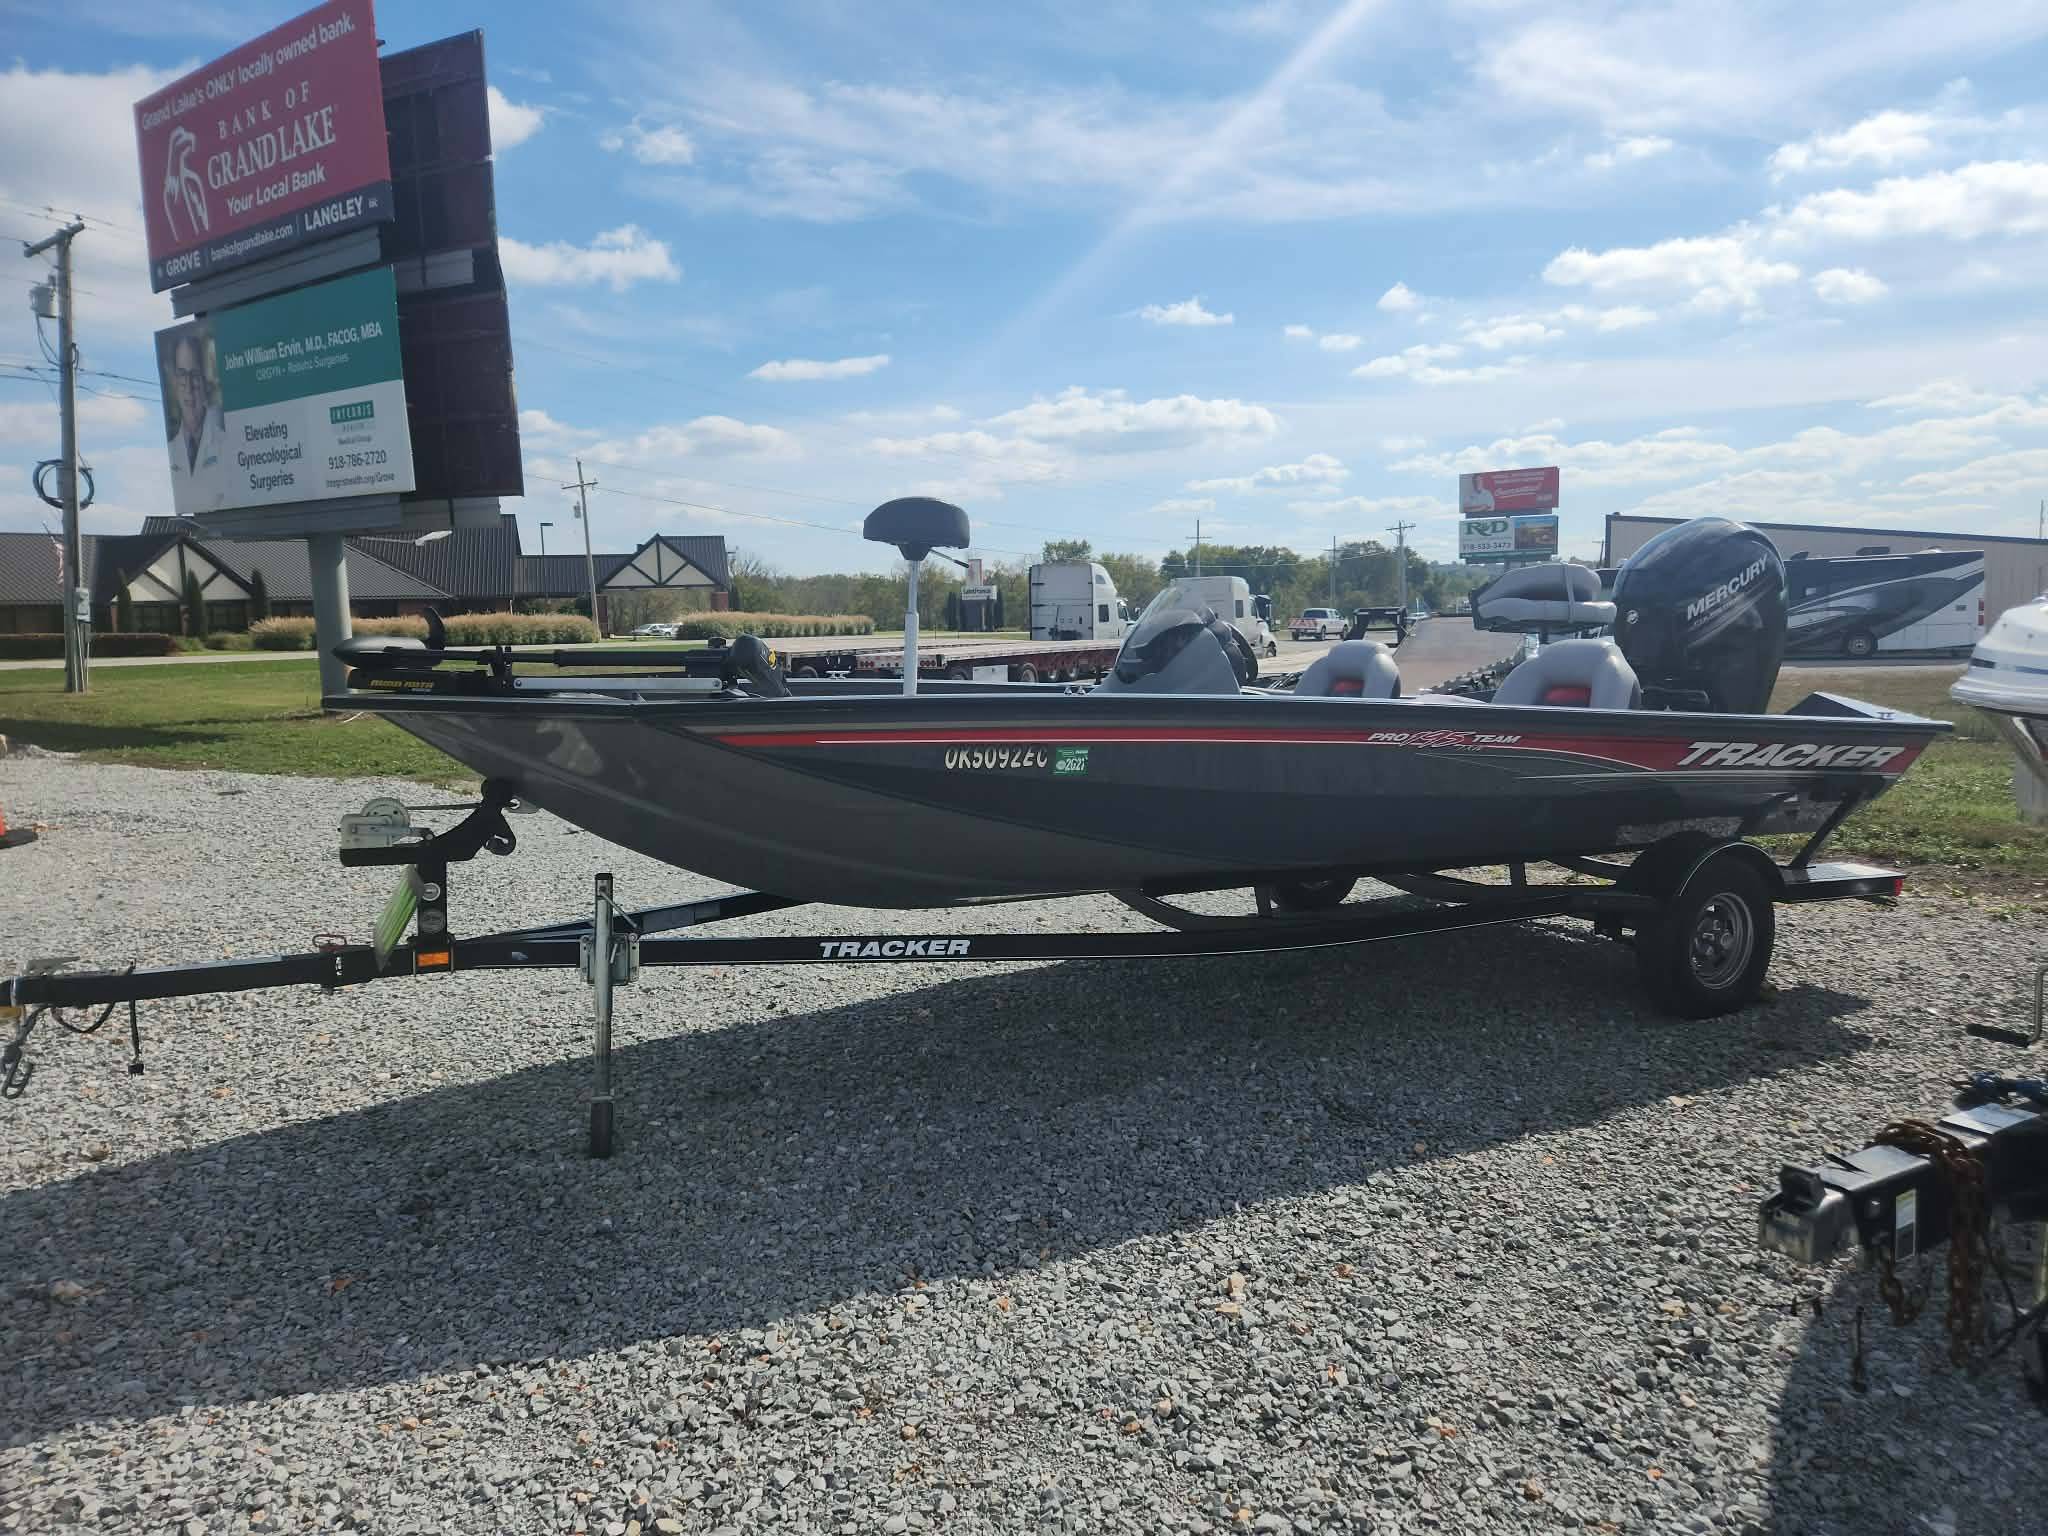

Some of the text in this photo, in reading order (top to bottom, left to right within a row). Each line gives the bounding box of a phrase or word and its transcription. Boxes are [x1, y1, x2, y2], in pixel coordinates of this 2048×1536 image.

[142, 12, 356, 130] Grand Lake's ONLY locally owned bank.
[217, 80, 311, 139] BANK OF
[226, 162, 327, 217] Your Local Bank
[166, 250, 201, 277] GROVE
[304, 196, 364, 232] LANGLEY
[224, 353, 245, 371] John
[246, 344, 278, 366] William
[278, 338, 305, 358] Ervin,
[327, 327, 361, 347] FACOG,
[361, 321, 383, 339] MBA
[244, 421, 289, 442] Elevating
[237, 443, 304, 471] Gynecological
[328, 449, 387, 470] 918-786-2720
[249, 470, 295, 492] Surgeries
[1687, 553, 1768, 621] MERCURY
[1367, 732, 1409, 742] PRO
[1472, 734, 1521, 744] TEAM
[1677, 741, 1905, 768] TRACKER
[819, 939, 971, 958] TRACKER
